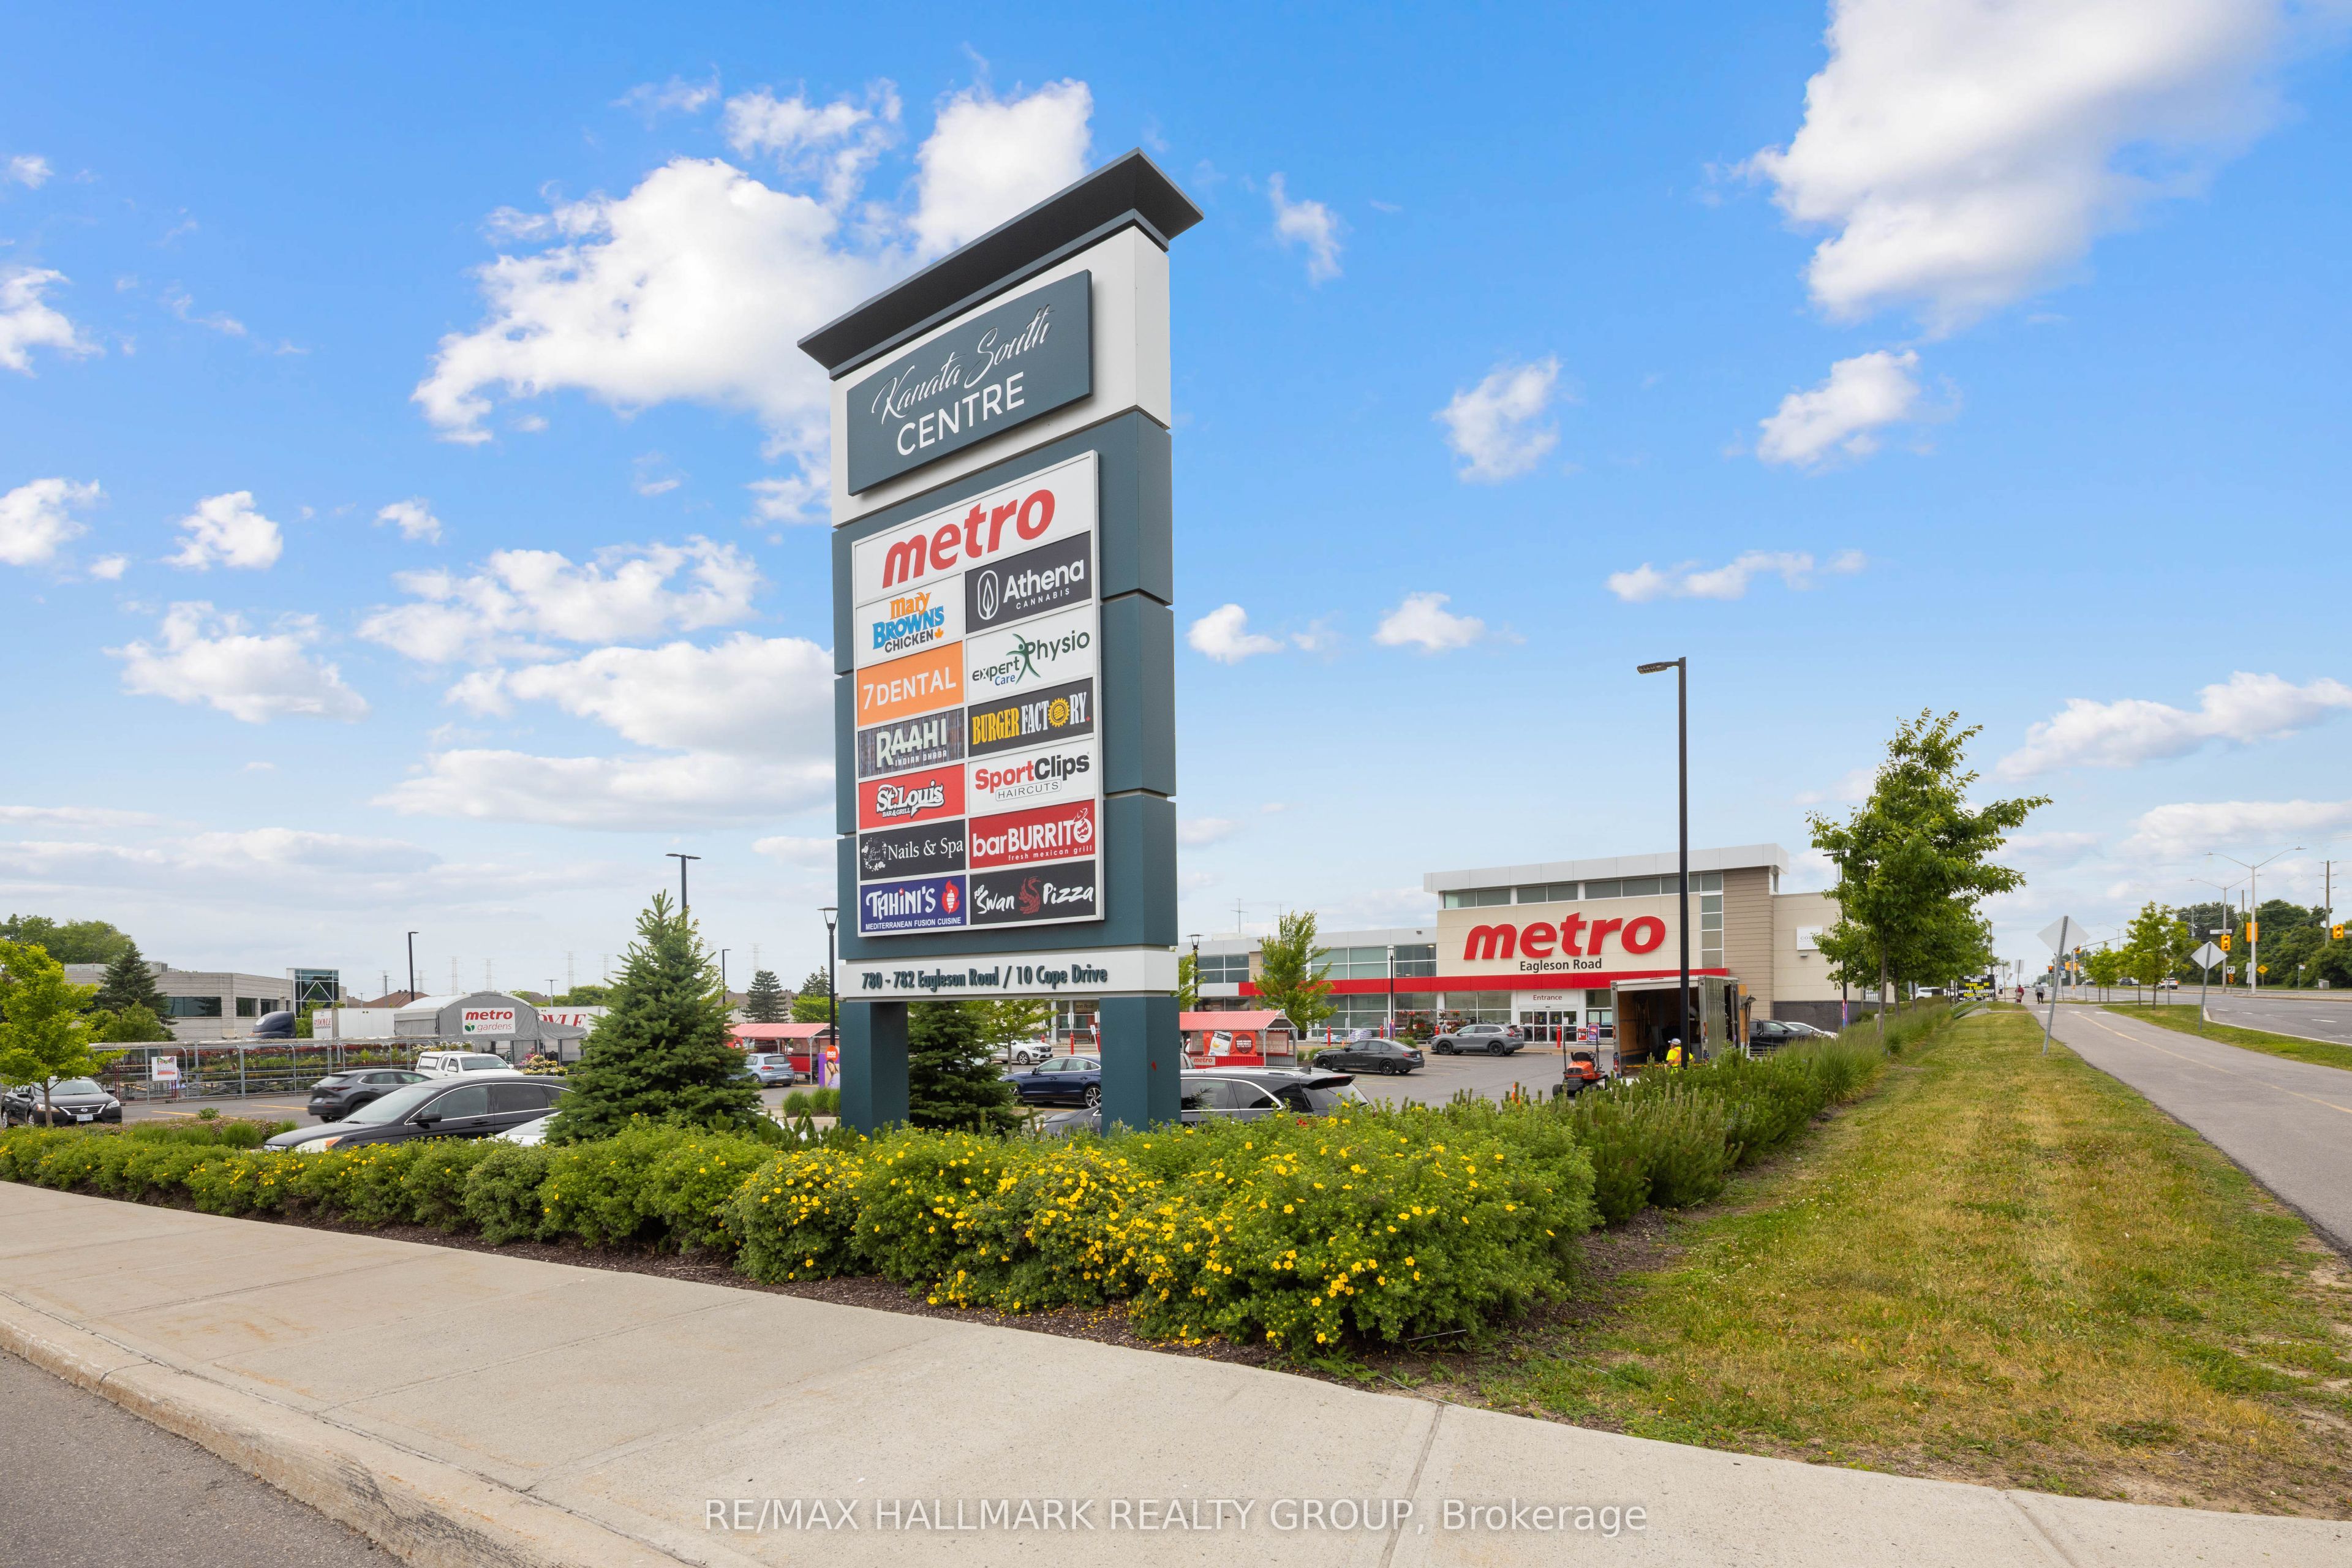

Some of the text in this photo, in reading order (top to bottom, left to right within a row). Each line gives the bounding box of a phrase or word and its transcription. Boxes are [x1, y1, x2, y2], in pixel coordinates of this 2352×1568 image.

[871, 304, 1054, 424] Kanata South
[897, 371, 1024, 455] CENTRE
[883, 489, 1055, 589] metro
[1003, 559, 1084, 603] Athena
[1016, 588, 1069, 609] CANNABIS
[885, 629, 933, 653] CHICKEN
[1025, 630, 1090, 661] Physio
[995, 674, 1015, 685] Care
[972, 707, 1019, 745] BURGER
[876, 718, 947, 767] RAAHI
[895, 750, 947, 766] INDIAN DHABA
[998, 782, 1058, 799] HAIRCUTS
[888, 837, 963, 860] Nails & Spa
[1033, 849, 1068, 858] mexican
[1073, 845, 1092, 854] grill
[974, 884, 985, 899] RED
[977, 883, 1093, 914] Swan Pizza
[865, 917, 961, 930] MEDITERRANEAN FUSION CUISINE
[1463, 912, 1666, 960] metro
[1520, 958, 1602, 973] Eagleson Road
[862, 972, 882, 989] 780
[894, 970, 914, 988] 782
[918, 969, 965, 992] Eagleson
[969, 966, 998, 986] Road
[1003, 966, 1012, 989] /
[1016, 966, 1031, 984] 10
[1036, 965, 1067, 989] Cope
[1072, 963, 1107, 984] Drive
[466, 1009, 513, 1020] metro
[477, 1022, 512, 1032] gardens
